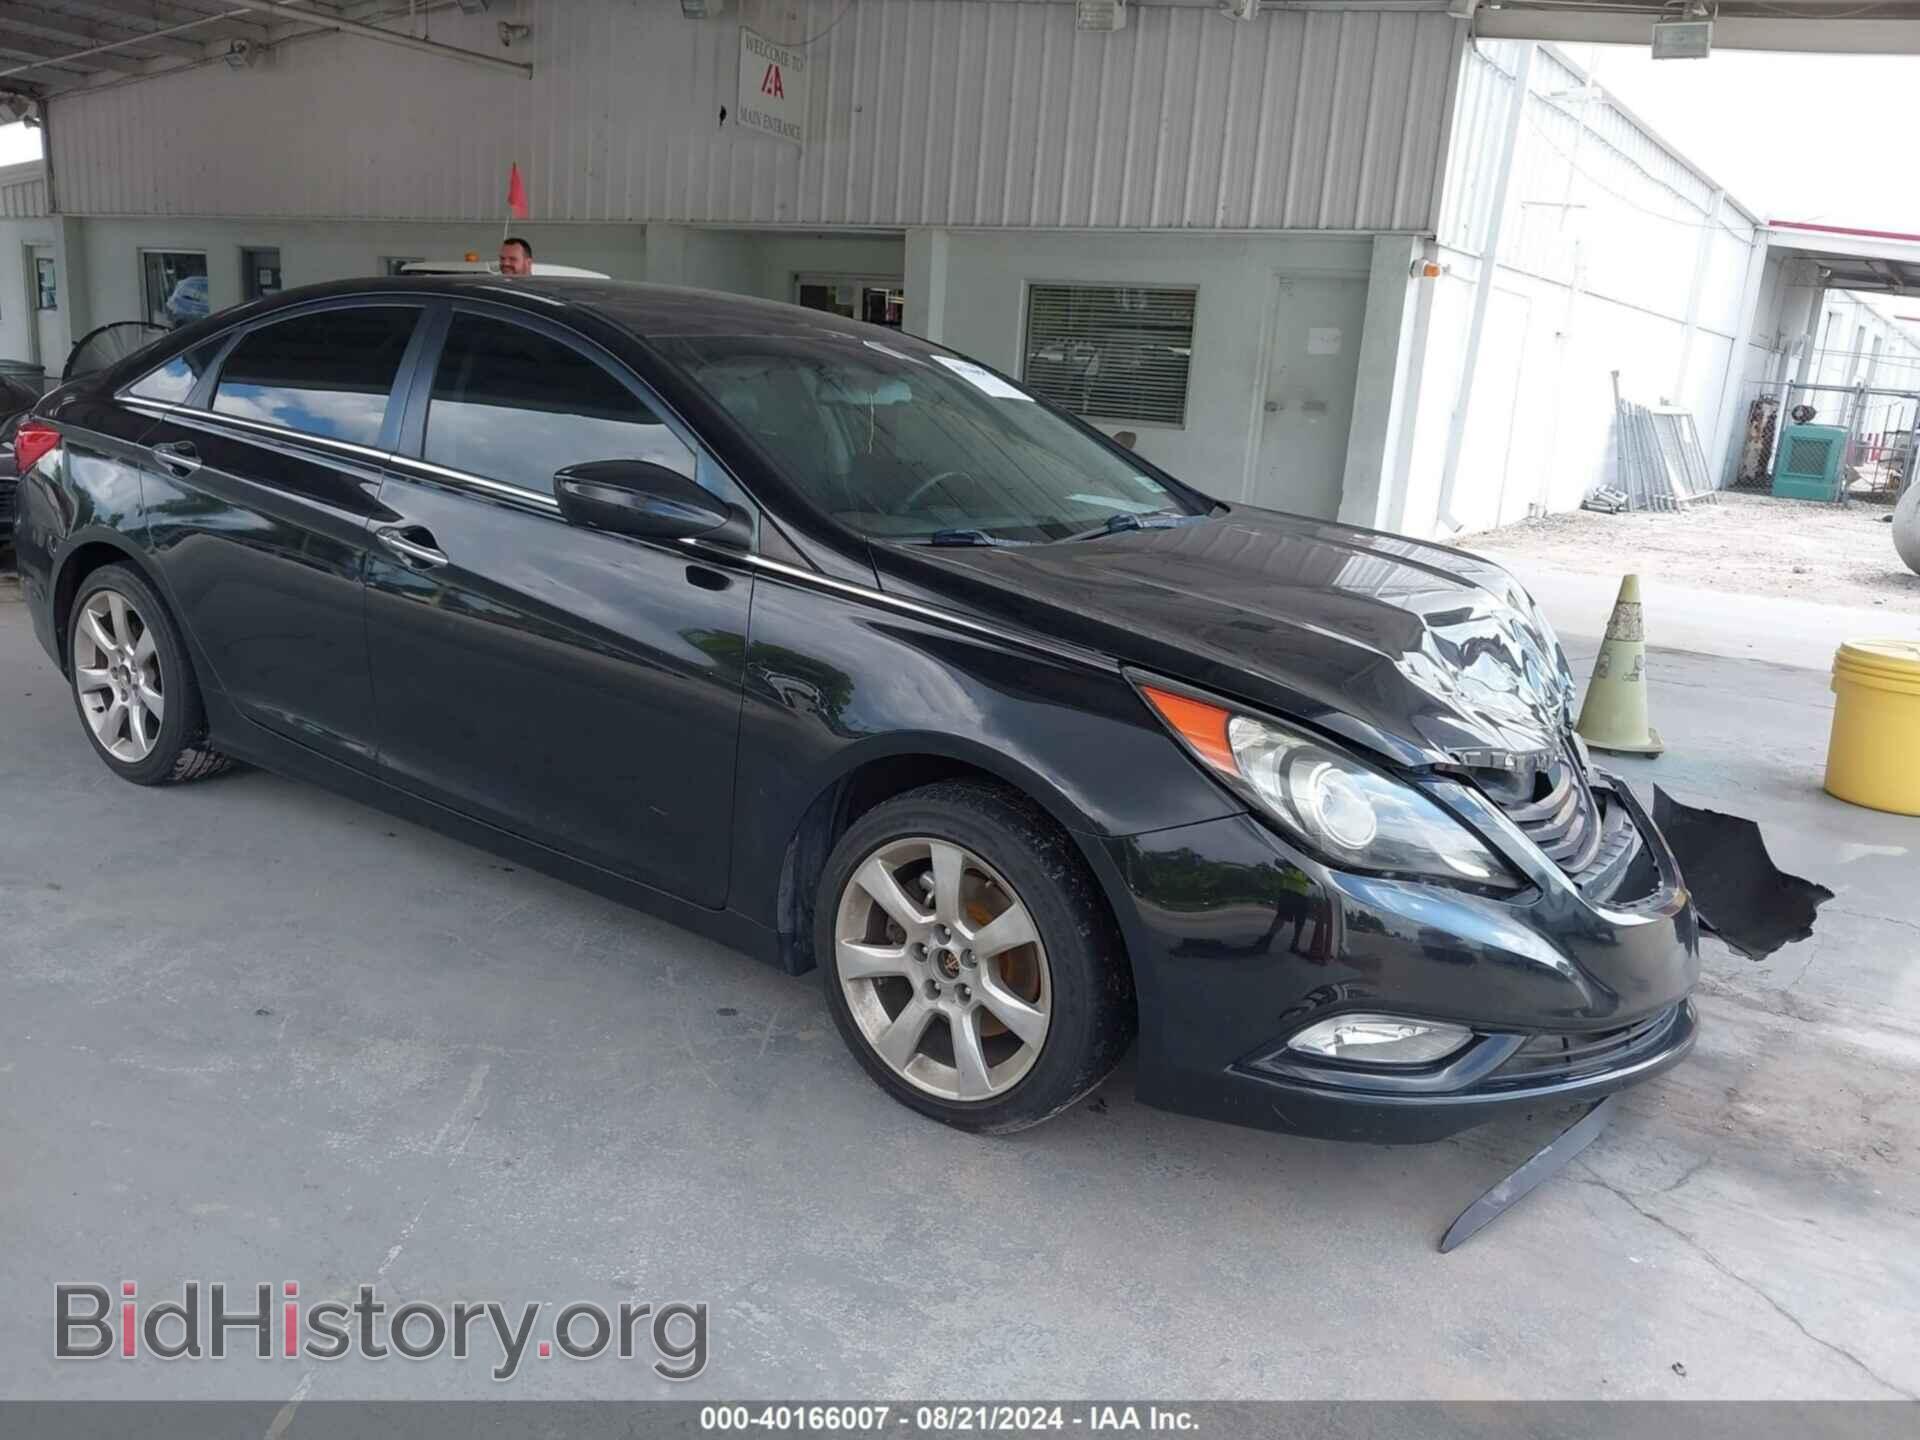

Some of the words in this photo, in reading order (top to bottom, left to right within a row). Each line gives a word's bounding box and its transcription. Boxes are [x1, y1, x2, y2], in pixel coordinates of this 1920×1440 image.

[745, 36, 790, 66] WELCOME
[792, 55, 805, 73] TO
[740, 105, 761, 127] MAIN
[763, 113, 801, 138] ENTRANCE
